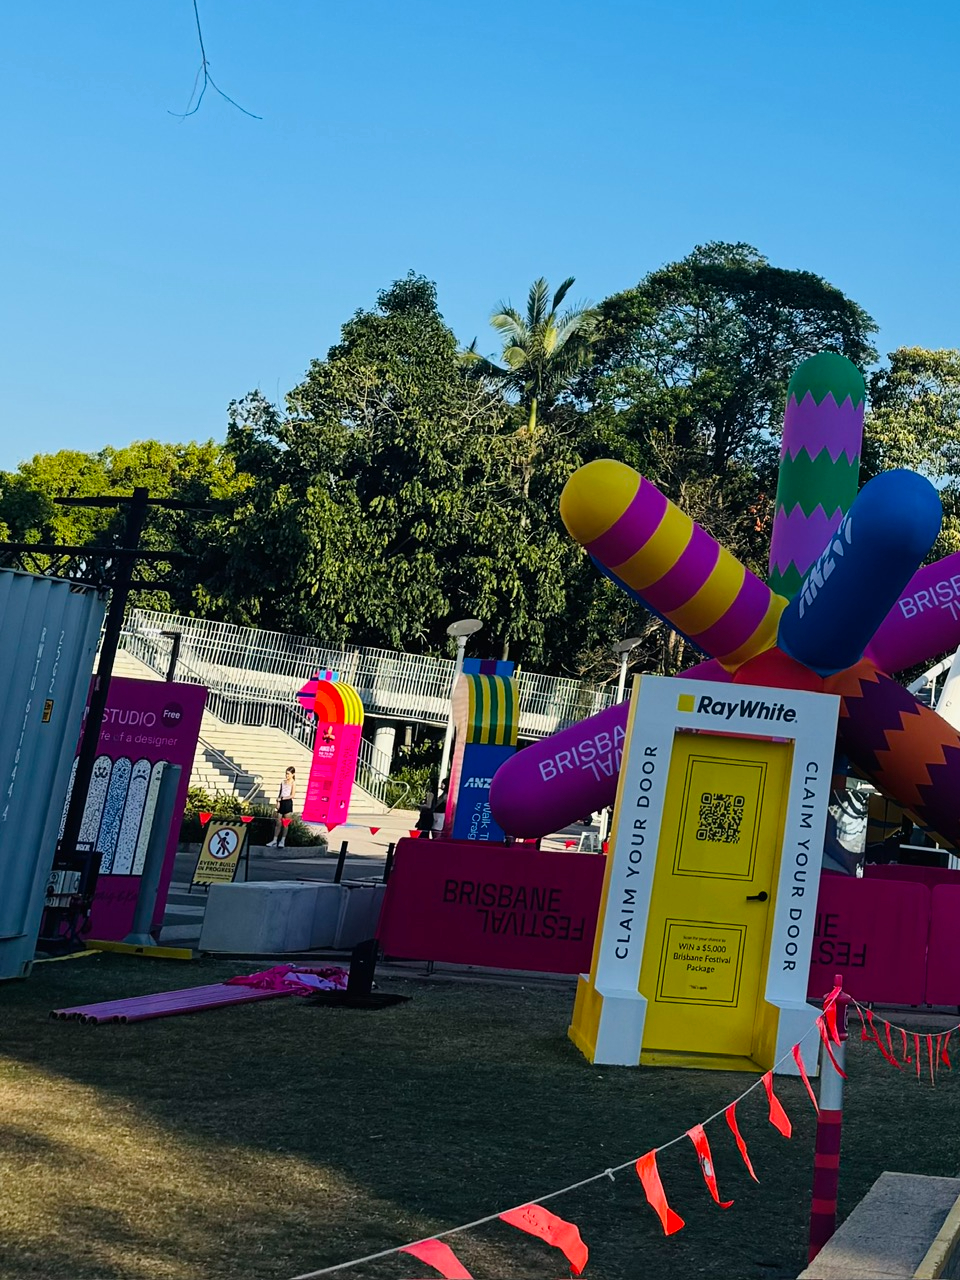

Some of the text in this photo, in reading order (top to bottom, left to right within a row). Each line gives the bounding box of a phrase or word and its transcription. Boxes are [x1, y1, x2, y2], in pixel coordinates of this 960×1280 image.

[101, 707, 156, 727] STUDIO
[163, 709, 180, 719] Free
[126, 735, 132, 743] a
[135, 733, 178, 747] designer
[464, 777, 492, 788] ANZ
[615, 745, 657, 959] CLAIM YOUR DOOR
[783, 761, 818, 971] CLAIM YOUR DOOR
[443, 879, 562, 912] BRISBANE
[477, 909, 585, 941] FESTIVAL
[679, 943, 694, 951] WIN
[702, 944, 727, 953] $5,000
[673, 953, 731, 964] Brisbane Festival
[687, 964, 715, 973] Package
